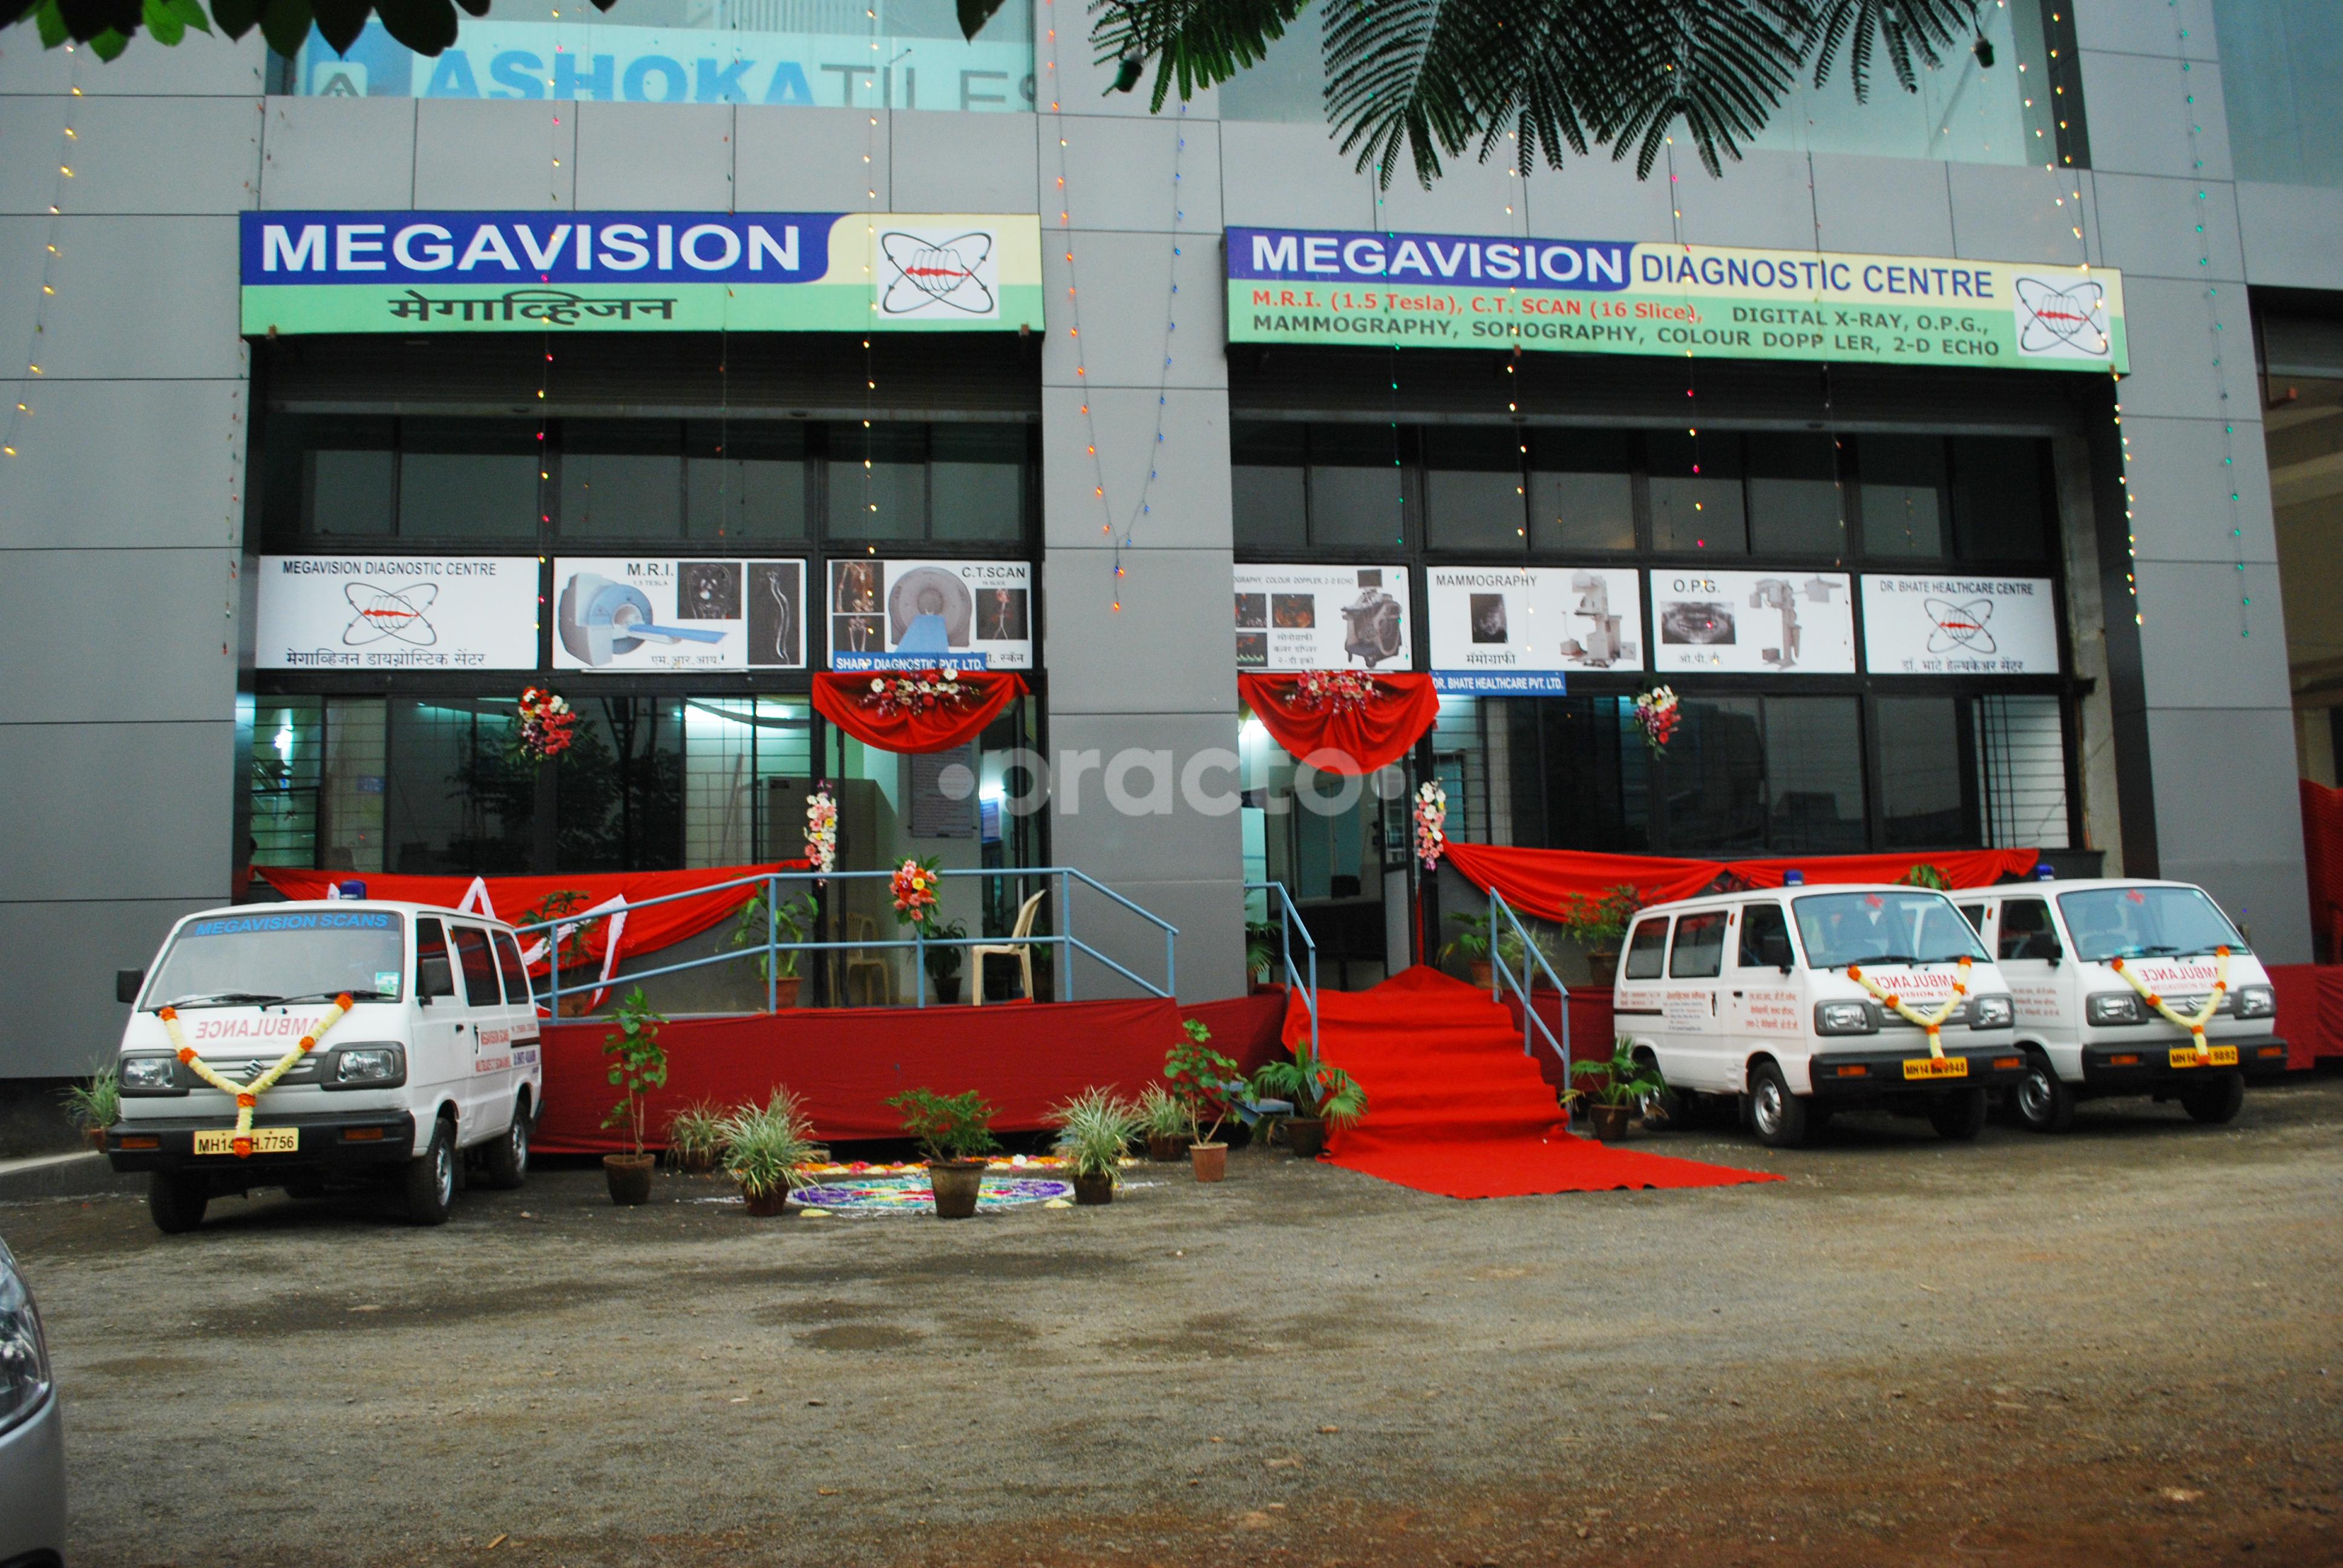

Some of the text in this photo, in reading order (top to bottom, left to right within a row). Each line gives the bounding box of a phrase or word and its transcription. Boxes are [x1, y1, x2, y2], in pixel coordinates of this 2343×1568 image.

[422, 50, 819, 106] ASHOKA
[261, 223, 801, 272] MEGAVISION
[1251, 235, 1624, 283] MEGAVISION
[1642, 255, 1995, 298] DIAGNOSTIC CENTRE
[387, 289, 678, 325] मेगाव्हिजन
[1252, 290, 1703, 325] M.R.I. (1.5 Tesla), C.T. SCAN (16 Slice),
[1732, 307, 1990, 336] DIGITAL X-RAY, O.P.G.,
[1253, 315, 1999, 357] MAMMOGRAPHY, SONOGRAPHY, COLOUR DOPP LER, 2-D ECHO
[283, 561, 497, 577] MEGAVISION DIAGNOSTIC CENTRE
[627, 563, 674, 577] M.R.I.
[1436, 575, 1537, 587] MAMMOGRAPHY
[1673, 579, 1721, 593] O.P.G.
[1879, 580, 2034, 595] DR. BHATE HEALTHCARE CENTRE
[287, 647, 361, 667] मेगाव्हिजन
[454, 647, 486, 667] सेंटर
[836, 657, 985, 671] SHARP DIAGNOSTIC PVT. LTD.
[1448, 677, 1474, 690] BHATE
[1475, 678, 1527, 690] HEALTHCARE
[1529, 678, 1545, 690] PVT.
[1547, 678, 1564, 690] LTD.
[195, 913, 389, 936] MEGAVISION SCANS
[250, 1135, 294, 1150] H.7756
